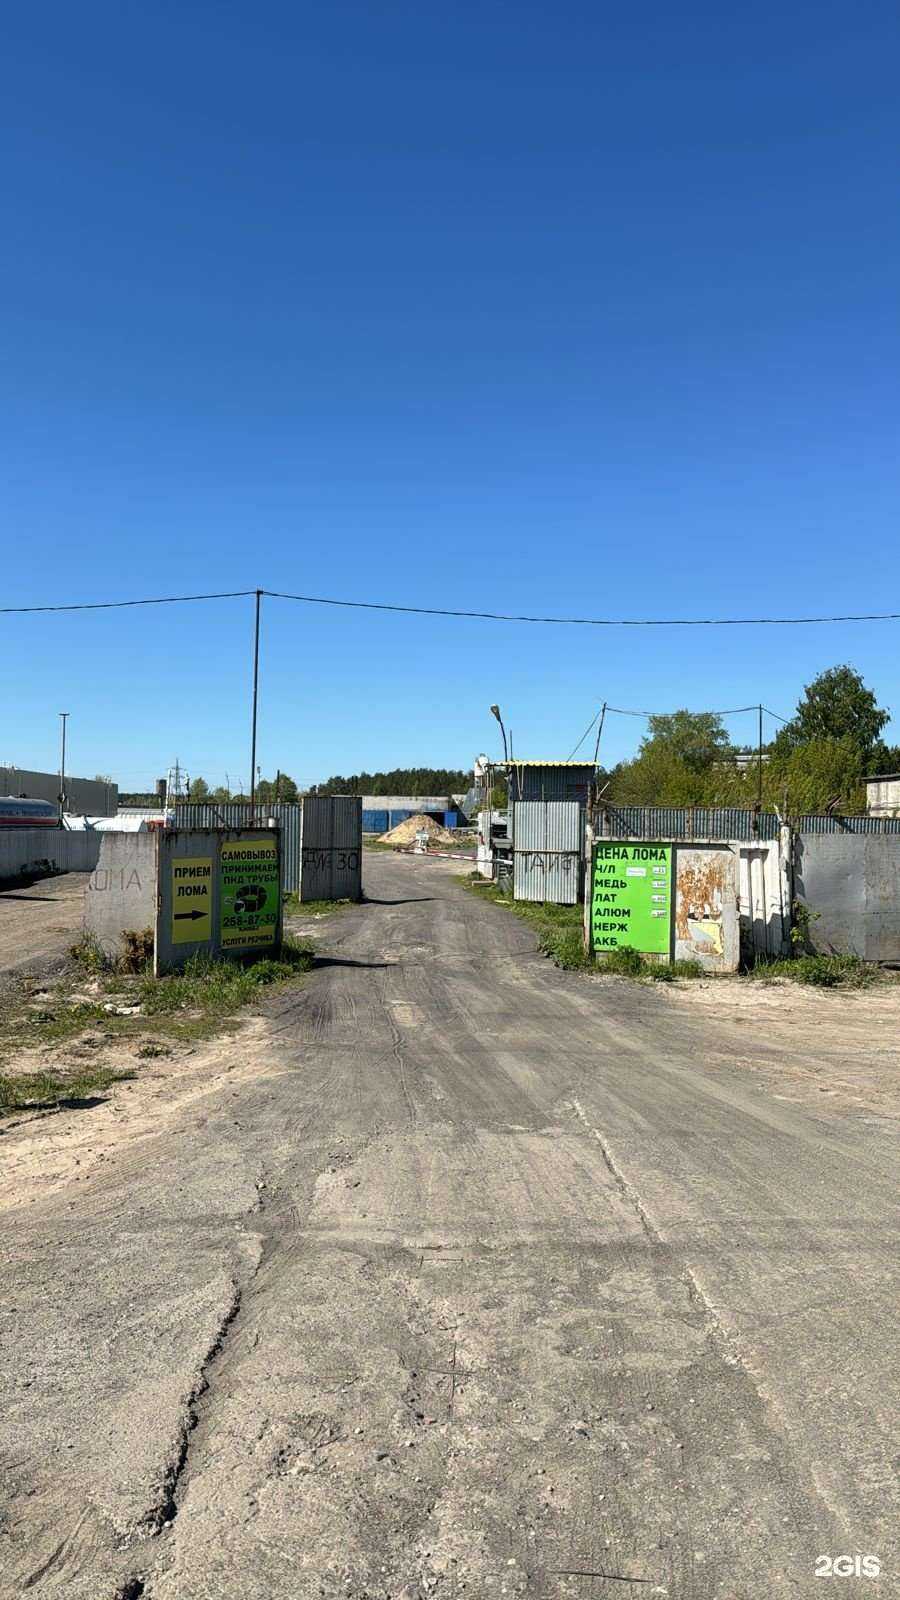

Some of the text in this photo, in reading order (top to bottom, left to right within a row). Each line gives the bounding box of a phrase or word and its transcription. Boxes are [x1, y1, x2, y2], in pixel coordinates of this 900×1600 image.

[222, 849, 276, 861] САМОВЫВОЗ
[595, 847, 667, 861] ЦЕНА ЛОМА
[174, 866, 211, 878] ПРИЕМ
[595, 864, 615, 874] Ч/Л
[224, 873, 277, 885] ПНД ТРУБЫ
[595, 879, 628, 888] МЕДЬ
[177, 884, 208, 896] ЛОМА
[595, 893, 617, 902] ЛАТ
[594, 908, 631, 917] АЛЮМ
[594, 922, 628, 932] НЕРЖ
[594, 936, 618, 946] АКБ
